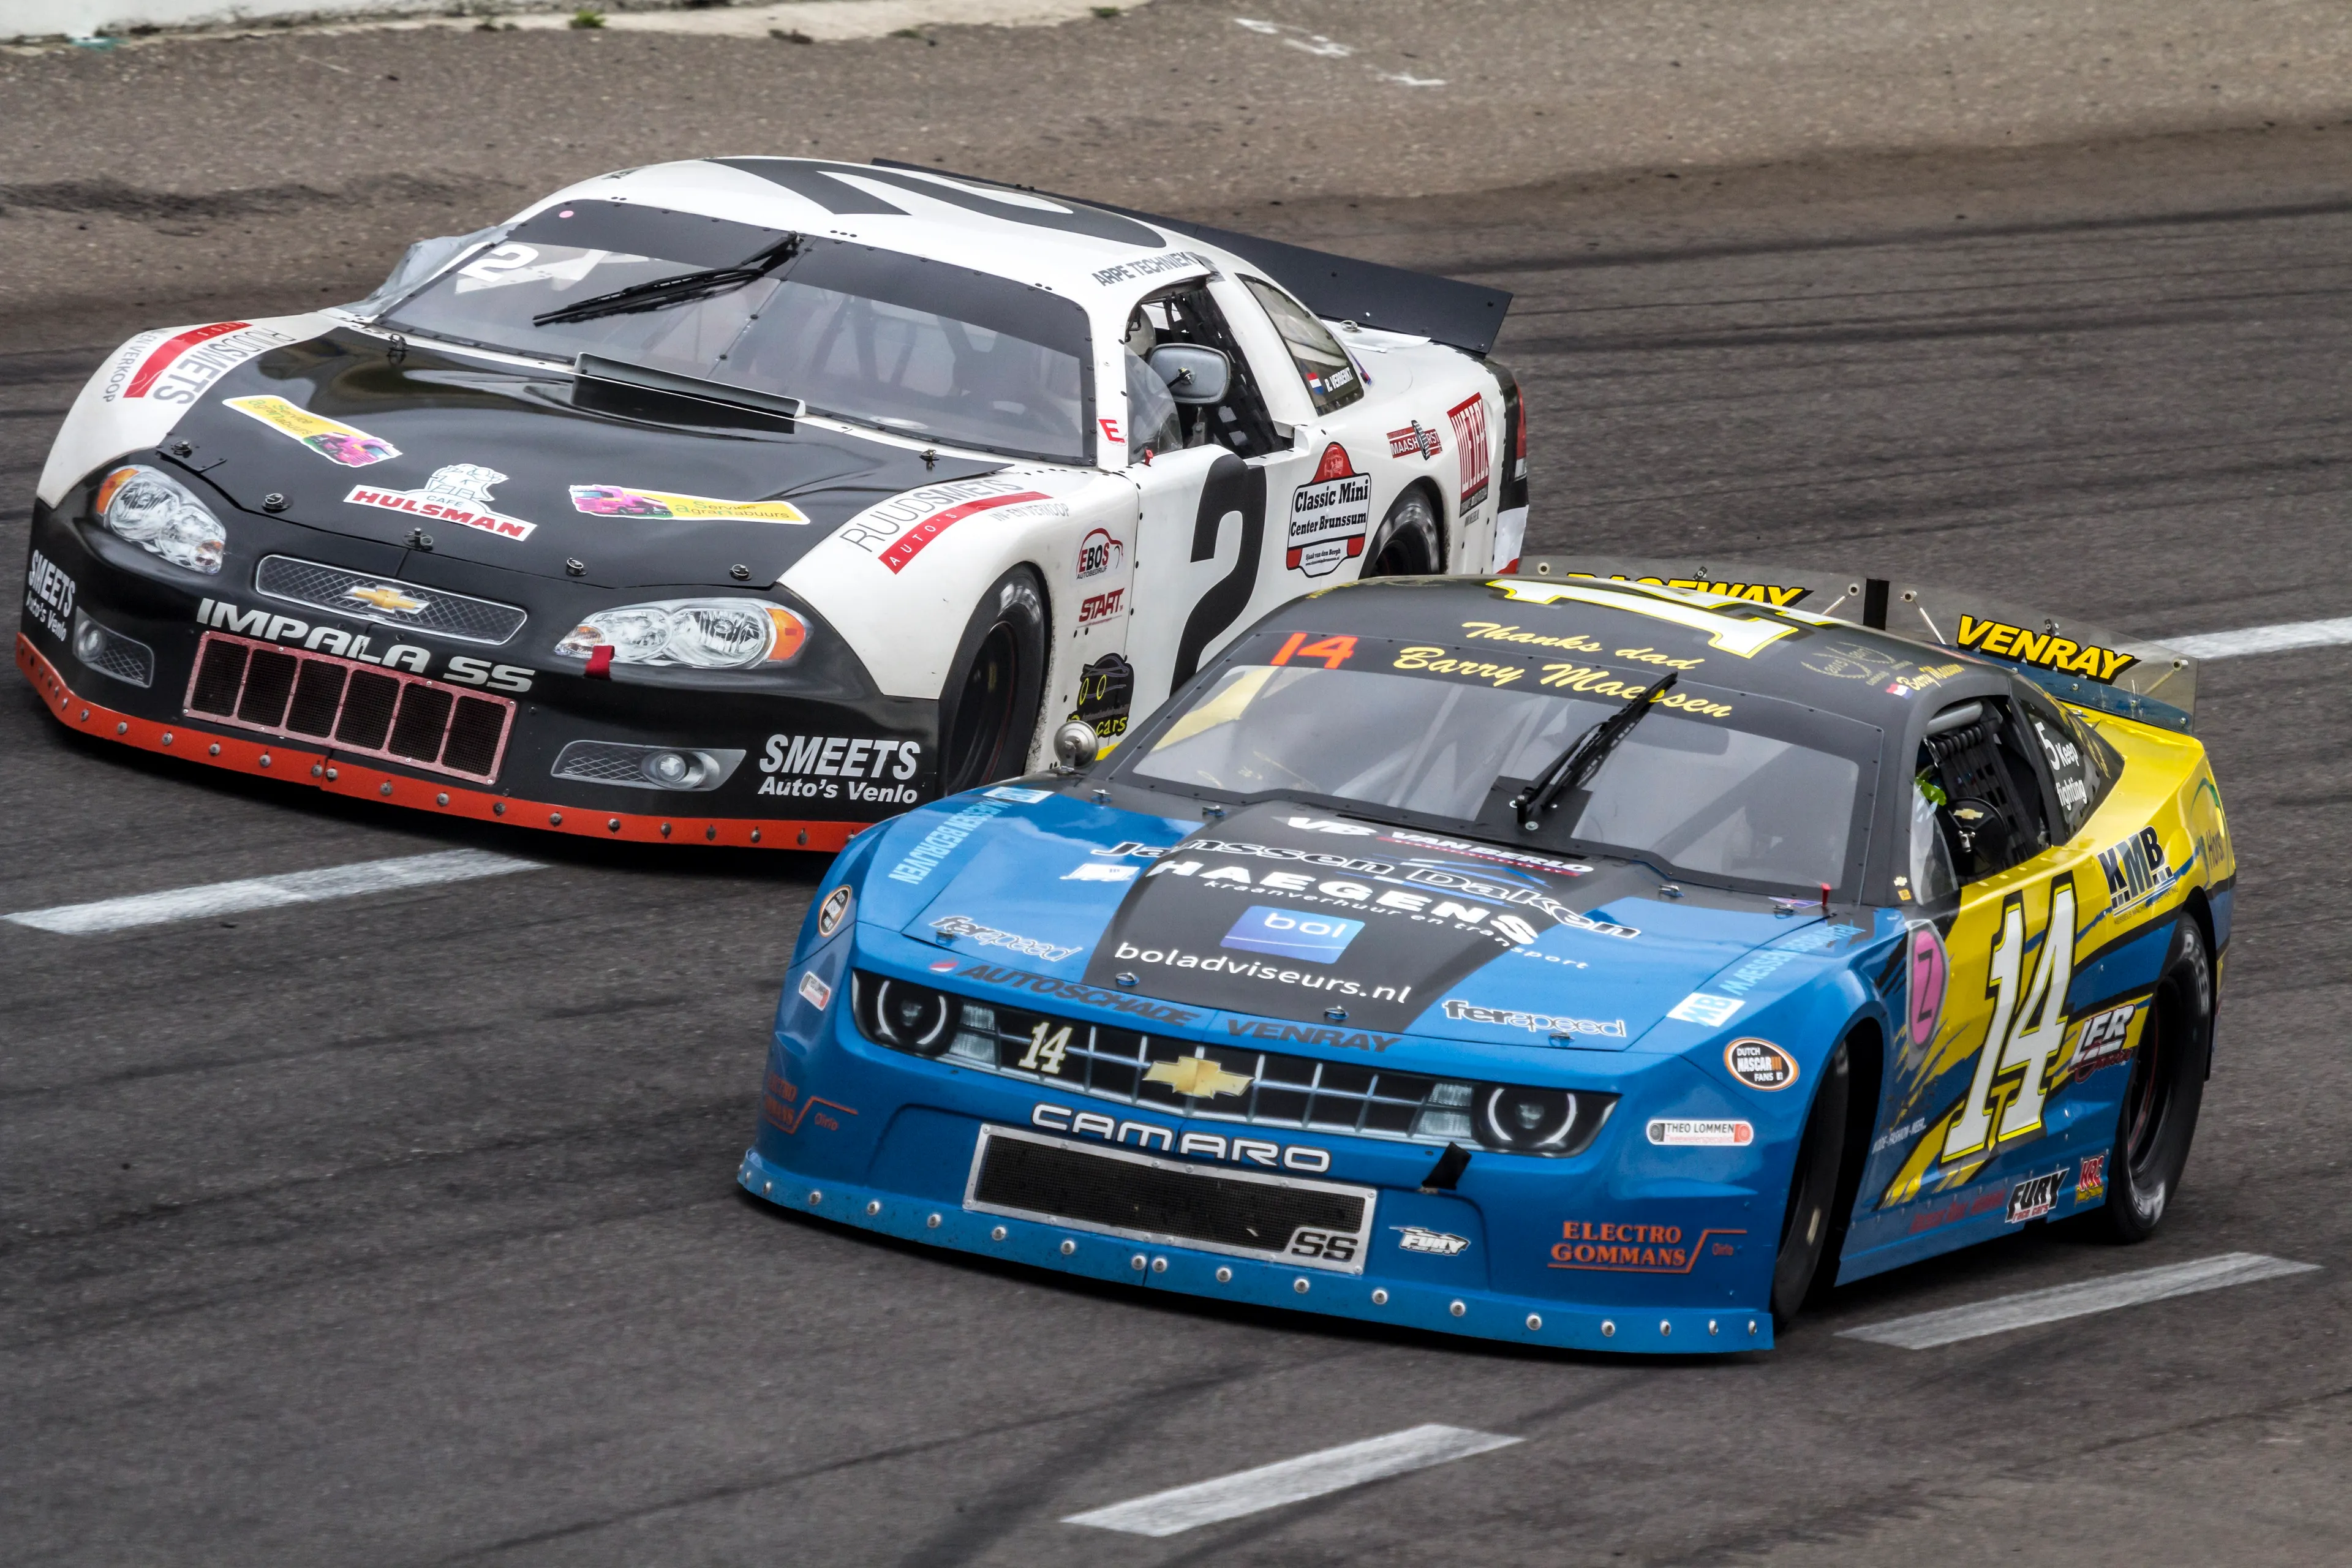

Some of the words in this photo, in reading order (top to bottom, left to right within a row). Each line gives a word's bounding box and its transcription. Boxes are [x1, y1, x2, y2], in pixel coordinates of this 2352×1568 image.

[1091, 265, 1136, 286] ARPE
[1126, 252, 1197, 275] TECHNIEK
[103, 345, 145, 402] VERKOOP
[1098, 419, 1125, 443] E
[1390, 431, 1440, 455] MAASHRST
[352, 491, 526, 531] HULSMAN
[426, 495, 464, 507] CAFÉ
[693, 501, 756, 510] Service
[1023, 503, 1069, 517] VERKOOP
[1295, 486, 1336, 513] Classic
[1338, 479, 1369, 503] Mini
[889, 513, 957, 566] AUTO'S
[1291, 520, 1319, 537] Center
[1319, 513, 1366, 530] Brunssum
[1077, 565, 1107, 579] AUTOBEDRIJF
[1079, 543, 1109, 573] EBOS
[1169, 453, 1267, 699] 2
[29, 549, 75, 617] SMEETS
[1079, 587, 1125, 622] START
[48, 610, 67, 641] Venlo
[196, 598, 429, 673] IMPALA
[443, 655, 535, 692] SS
[1271, 633, 1358, 670] 14
[1462, 622, 1602, 653] Thanks
[1615, 647, 1705, 670] dad
[1958, 614, 2138, 683] VENRAY
[1393, 647, 1525, 687] Barry
[1096, 717, 1127, 735] cars
[760, 734, 920, 780] SMEETS
[2035, 722, 2060, 771] 5
[758, 776, 839, 798] Auto's
[848, 781, 918, 804] Venlo
[888, 826, 970, 884] BEDRIJVEN
[1392, 832, 1471, 850] VAN
[1468, 846, 1594, 872] BERLO
[2097, 826, 2165, 899] KMB
[1090, 839, 1395, 875] Janssen
[1406, 868, 1642, 939] Daken
[1145, 861, 1538, 944] HAEGENS
[1204, 880, 1401, 916] kraanverhuur
[1411, 914, 1444, 924] en
[1453, 923, 1589, 969] transport
[1265, 913, 1346, 937] bol
[1115, 942, 1411, 1003] boladviseurs.nl
[1681, 995, 1732, 1027] MB
[1719, 949, 1800, 995] MAESSEN
[957, 965, 1200, 1026] AUTOSCHADE
[1227, 1019, 1403, 1052] VENRAY
[1941, 882, 2075, 1164] 14
[1018, 1022, 1072, 1074] 14
[1736, 1047, 1760, 1056] DUTCH
[1737, 1056, 1772, 1072] NASCAR
[1754, 1072, 1773, 1081] FANS
[1032, 1103, 1330, 1173] CAMARO
[1667, 1123, 1691, 1133] THEO
[1694, 1123, 1735, 1133] LOMMEN
[2006, 1170, 2067, 1221] FURY
[2013, 1209, 2030, 1221] race
[2031, 1204, 2049, 1216] cars
[1291, 1232, 1359, 1262] SS
[1563, 1221, 1682, 1243] ELECTRO
[1551, 1243, 1686, 1266] GOMMANS
